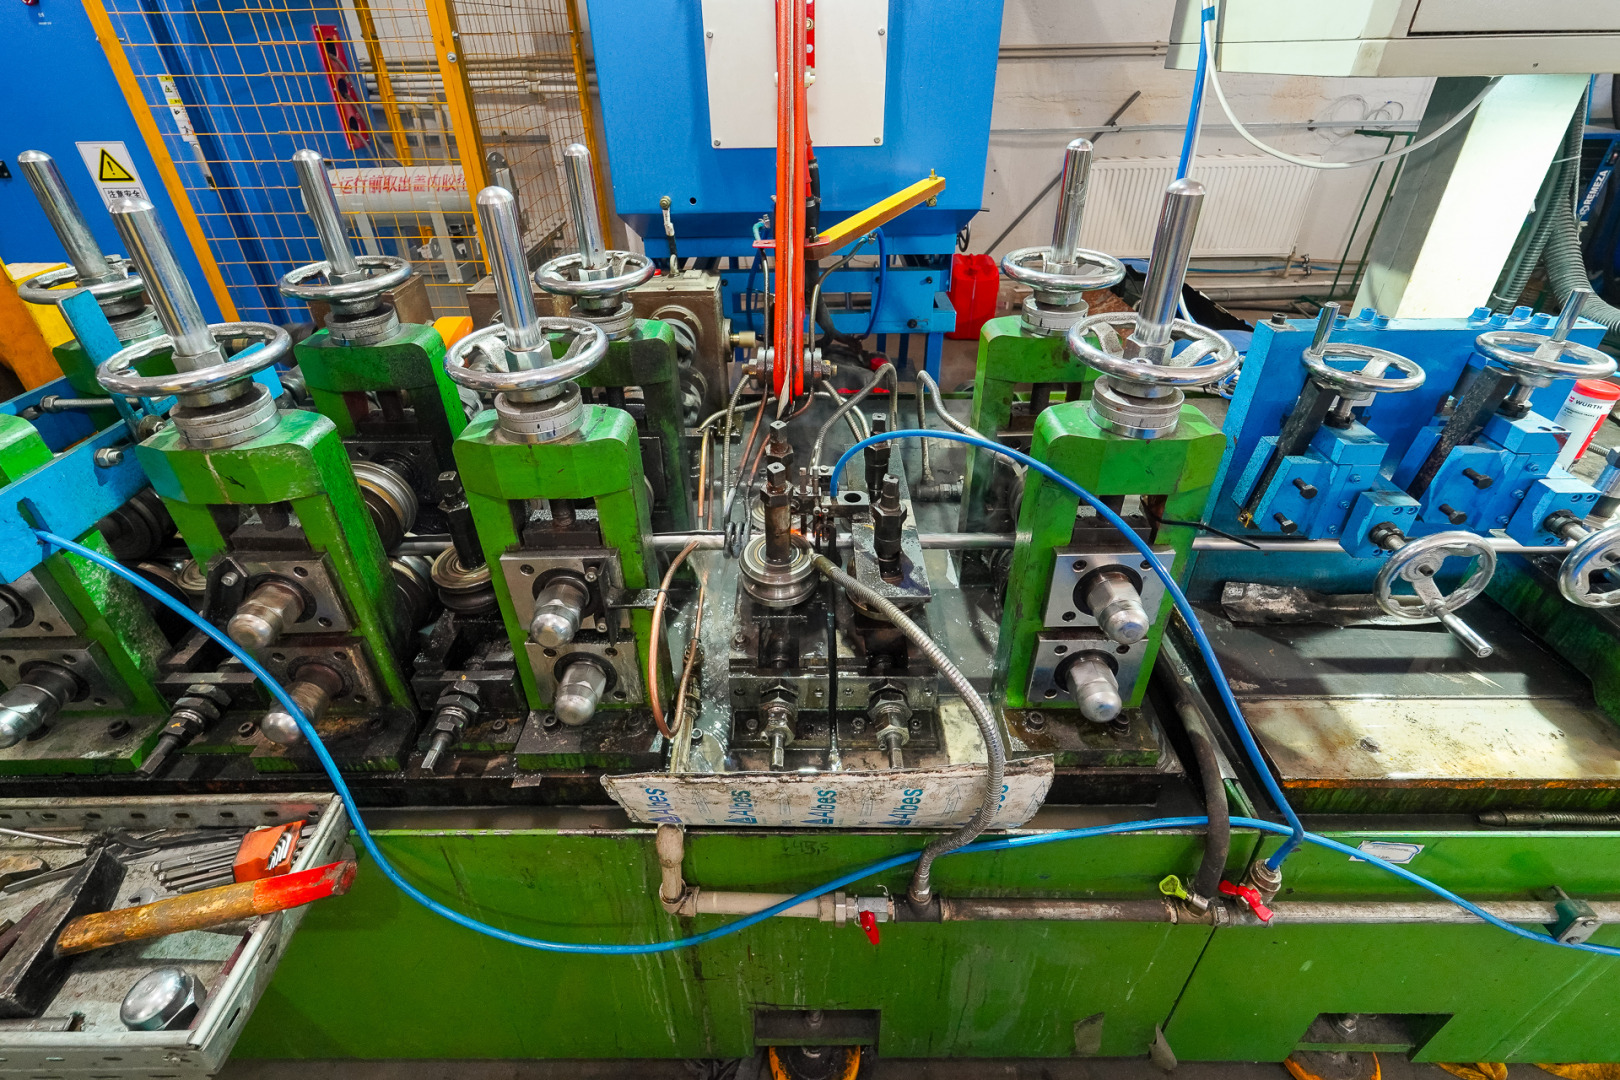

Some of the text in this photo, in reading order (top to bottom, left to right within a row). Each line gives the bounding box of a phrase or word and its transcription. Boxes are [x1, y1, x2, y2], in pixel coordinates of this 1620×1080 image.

[107, 190, 141, 199] 注意安全
[1583, 170, 1608, 205] REMEZA
[645, 788, 677, 816] Albes
[728, 790, 755, 817] Albes
[808, 790, 837, 818] Albes
[888, 789, 923, 820] Albes
